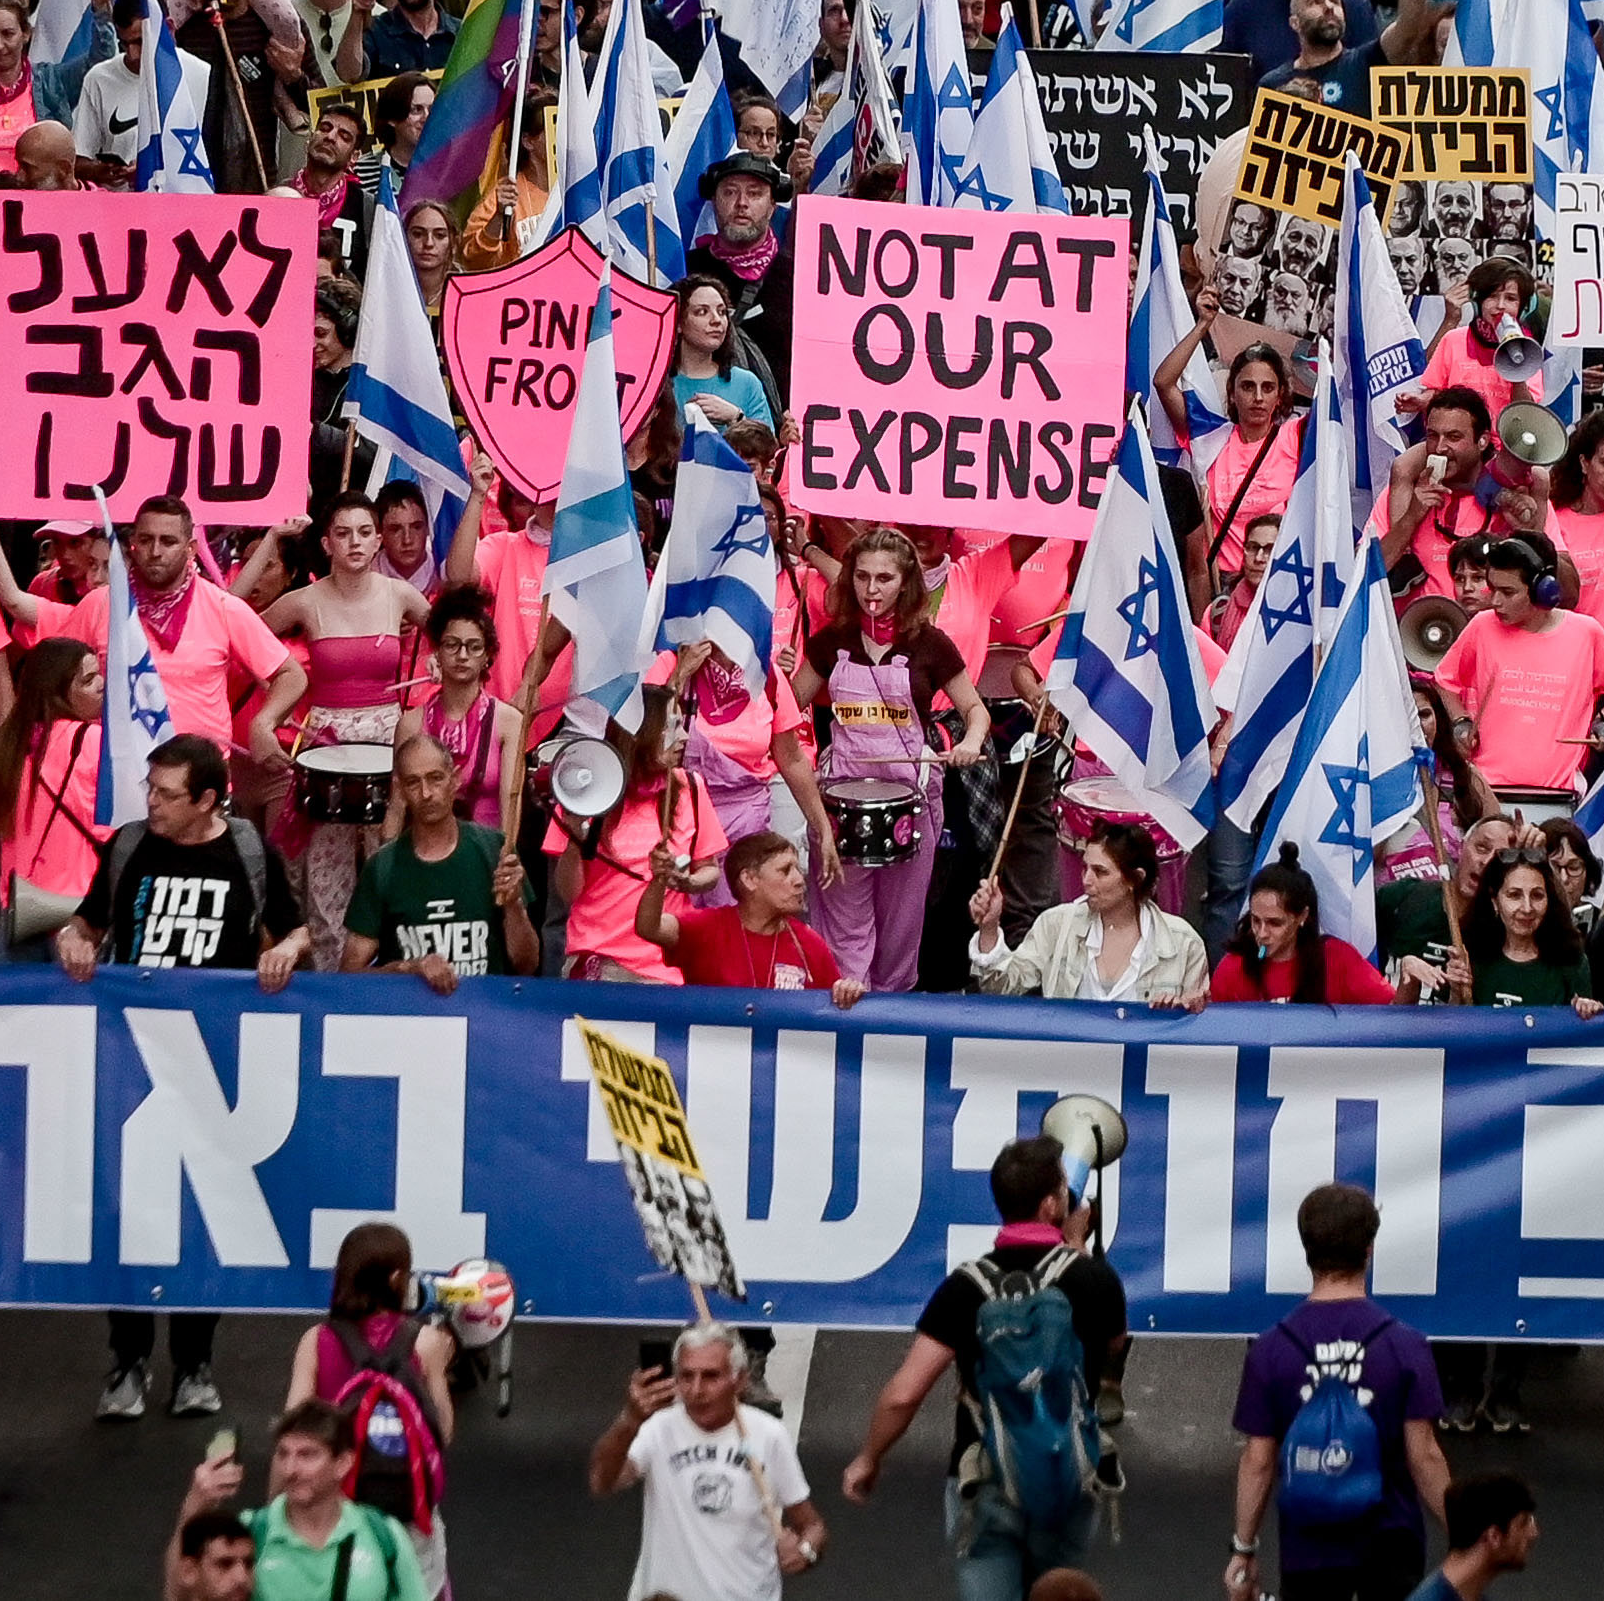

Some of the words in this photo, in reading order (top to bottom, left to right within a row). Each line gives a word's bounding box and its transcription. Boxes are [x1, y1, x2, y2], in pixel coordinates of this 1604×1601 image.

[1037, 73, 1157, 116] אשתו
[1177, 62, 1233, 120] לא
[1379, 72, 1526, 117] ממשלת
[1254, 98, 1402, 180] ממשלת
[3, 200, 147, 313] על
[166, 208, 293, 328] לא
[817, 223, 973, 300] NOT
[988, 231, 1115, 313] AT
[26, 322, 261, 406] הגב
[485, 357, 636, 412] FROT
[852, 303, 1062, 401] OUR
[1367, 345, 1409, 375] חופשי
[1369, 361, 1413, 395] בארצנו
[34, 397, 282, 502] שלנו
[802, 404, 1115, 510] EXPENSE
[152, 877, 230, 919] דמו
[141, 915, 225, 966] קרט
[396, 920, 488, 962] NEVER
[583, 1030, 680, 1110] ממשלת
[562, 1016, 1446, 1298] חופשי
[600, 1079, 699, 1169] הביזה
